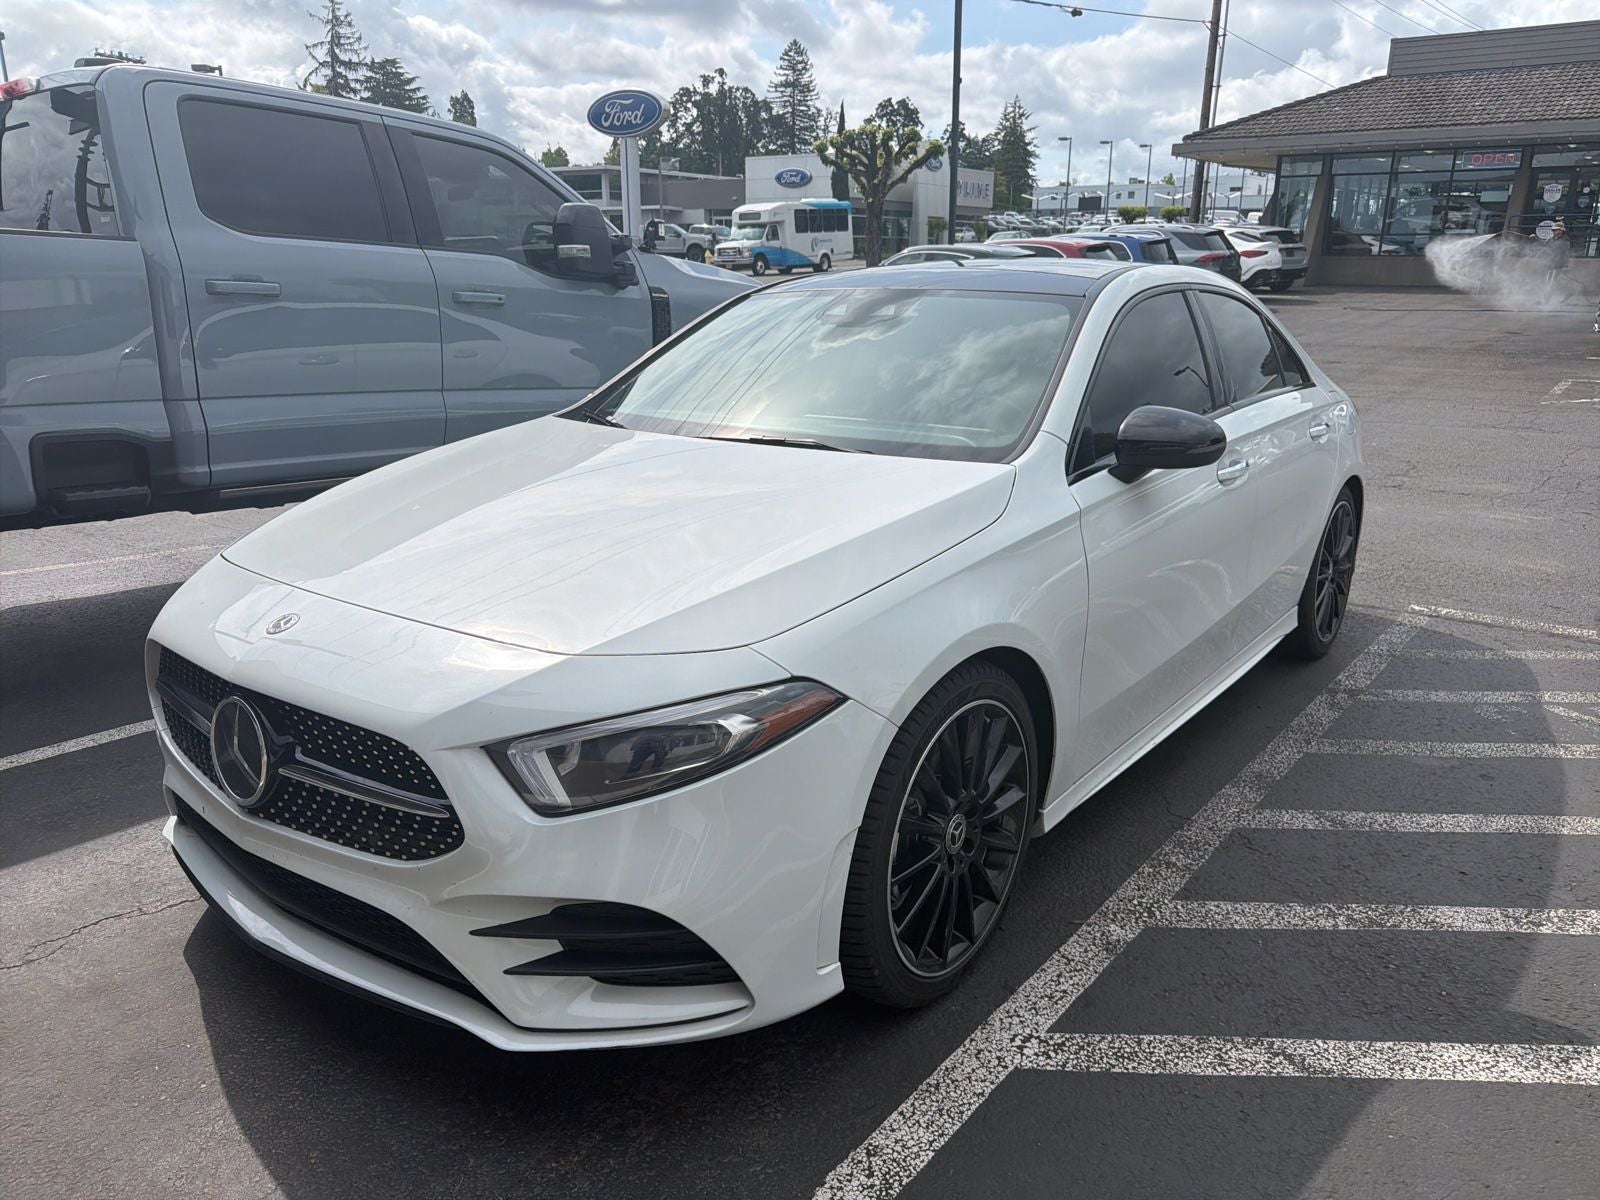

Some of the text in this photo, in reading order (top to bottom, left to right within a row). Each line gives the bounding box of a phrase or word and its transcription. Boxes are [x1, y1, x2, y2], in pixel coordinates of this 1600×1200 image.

[601, 99, 645, 127] Ford
[1471, 153, 1515, 165] OPEN
[780, 171, 802, 183] Ford
[957, 180, 990, 197] YLINE
